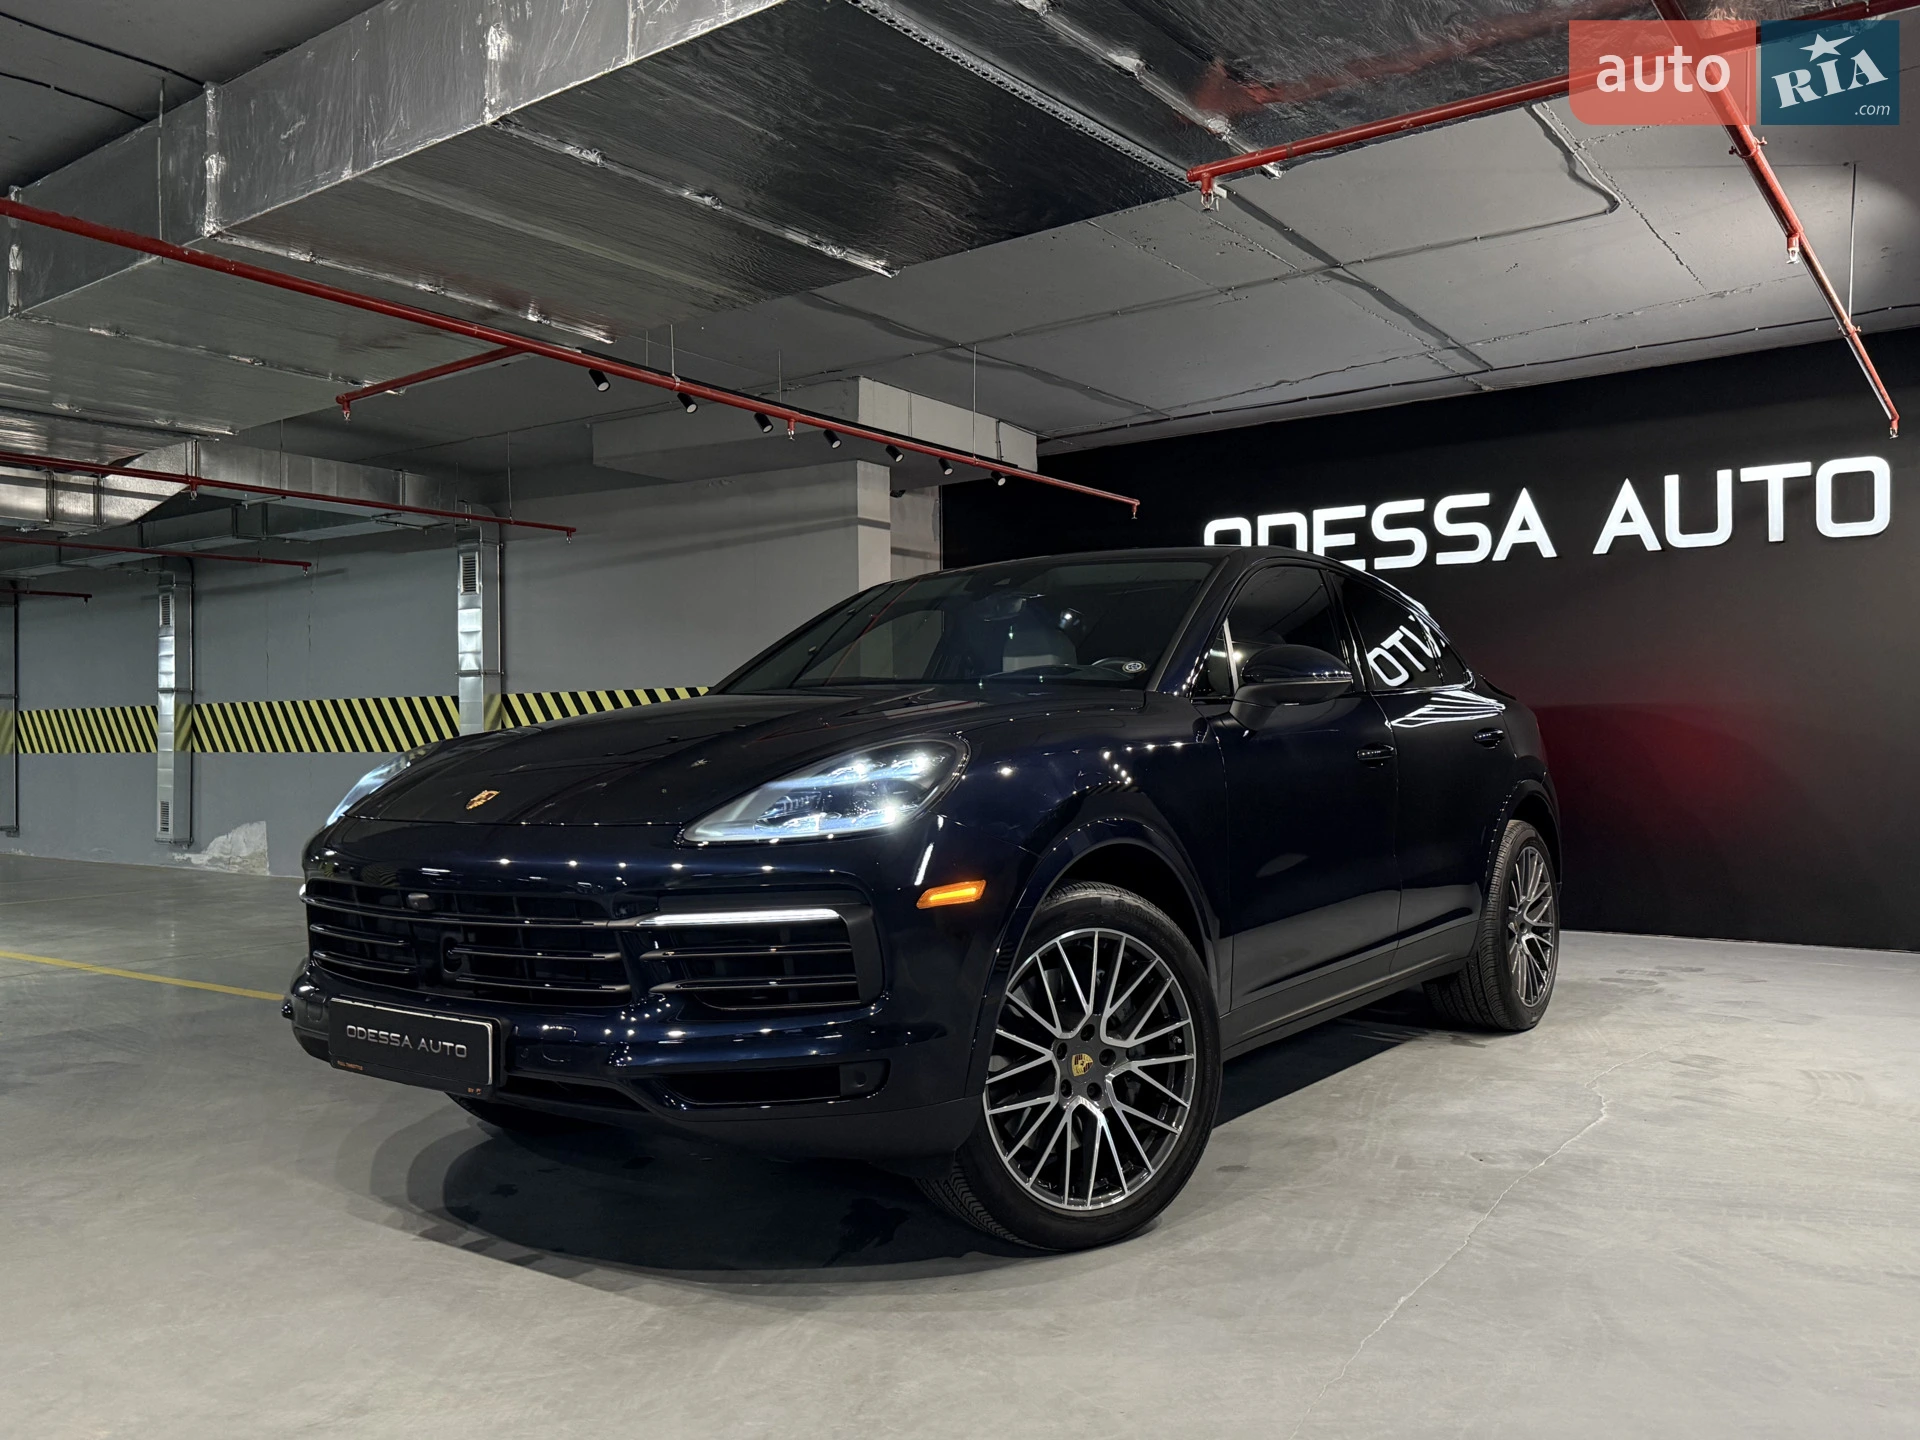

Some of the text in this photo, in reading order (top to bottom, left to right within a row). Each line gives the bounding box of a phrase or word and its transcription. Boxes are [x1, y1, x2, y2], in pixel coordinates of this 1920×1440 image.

[1592, 456, 1891, 555] AUTO
[346, 1024, 468, 1058] ODESSA AUTO
